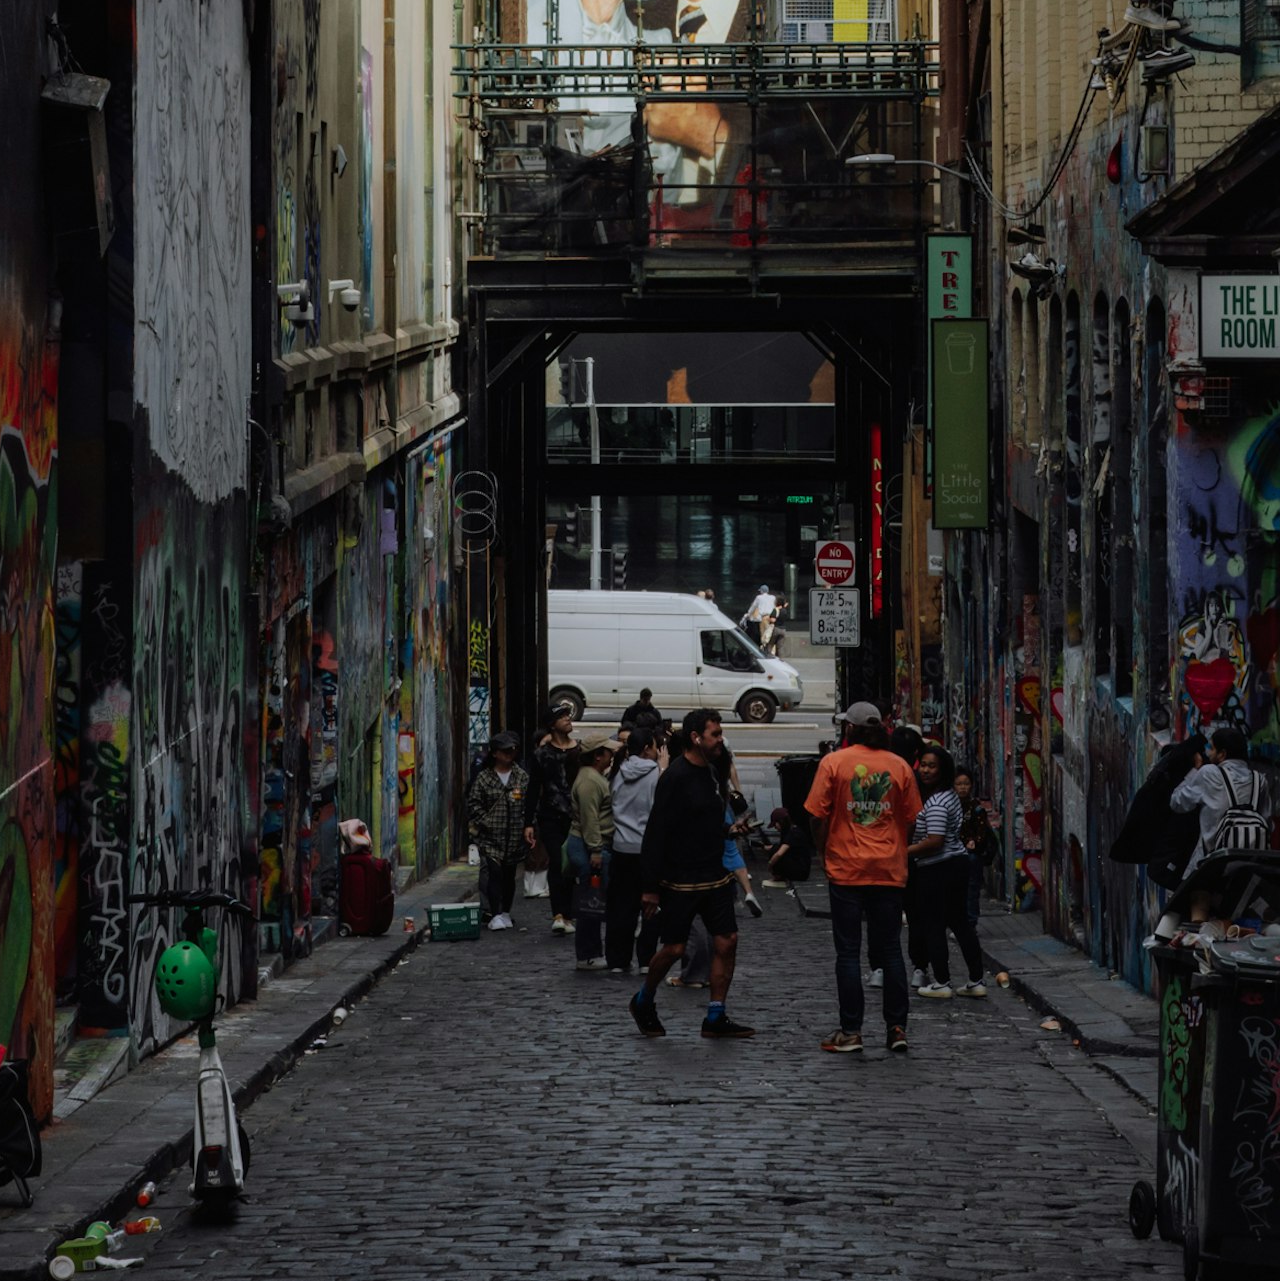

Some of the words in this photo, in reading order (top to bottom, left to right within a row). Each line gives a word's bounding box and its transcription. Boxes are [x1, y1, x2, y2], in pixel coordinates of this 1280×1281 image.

[941, 251, 960, 319] TRE
[1220, 286, 1256, 315] THE
[1221, 318, 1276, 349] ROOM
[941, 472, 982, 488] Little
[942, 488, 982, 504] Social
[829, 549, 842, 559] NO
[821, 569, 849, 579] ENTRY
